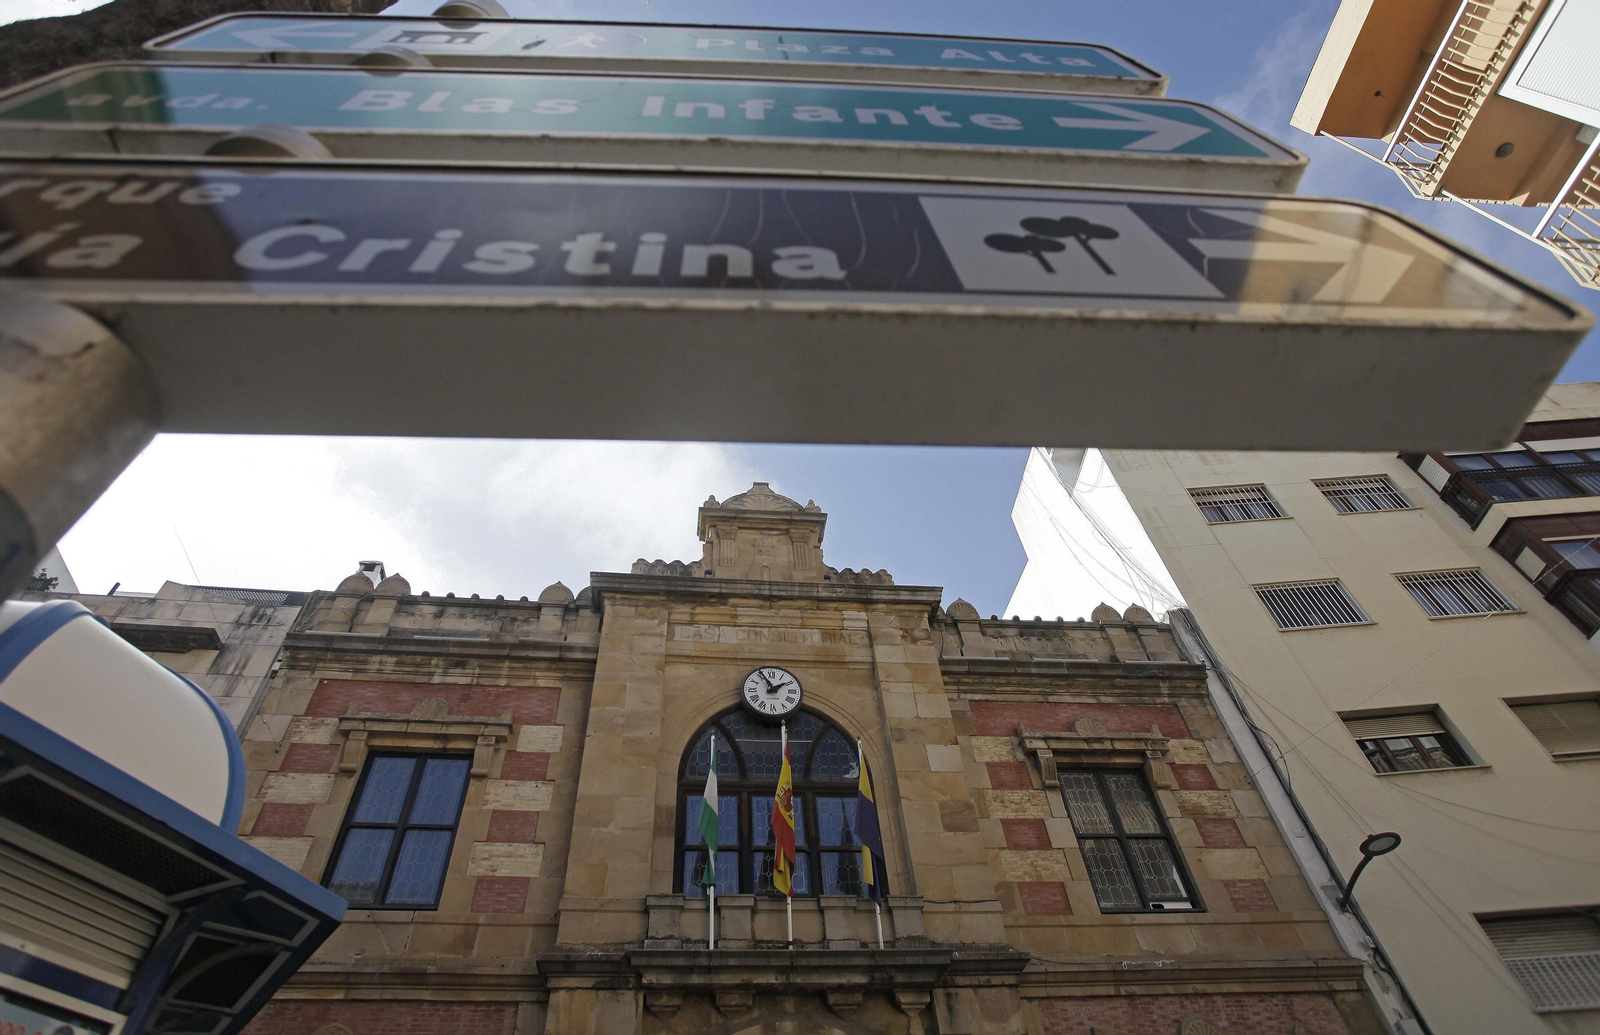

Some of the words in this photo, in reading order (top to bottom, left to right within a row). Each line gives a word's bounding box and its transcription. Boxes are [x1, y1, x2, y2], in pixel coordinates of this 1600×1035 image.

[695, 37, 896, 57] Plaza
[939, 47, 1097, 68] Alta
[337, 89, 579, 117] Blas
[641, 95, 1024, 131] Infante
[233, 223, 847, 281] Cristina
[679, 627, 730, 641] CASA
[735, 628, 859, 646] CONSISTORIAL
